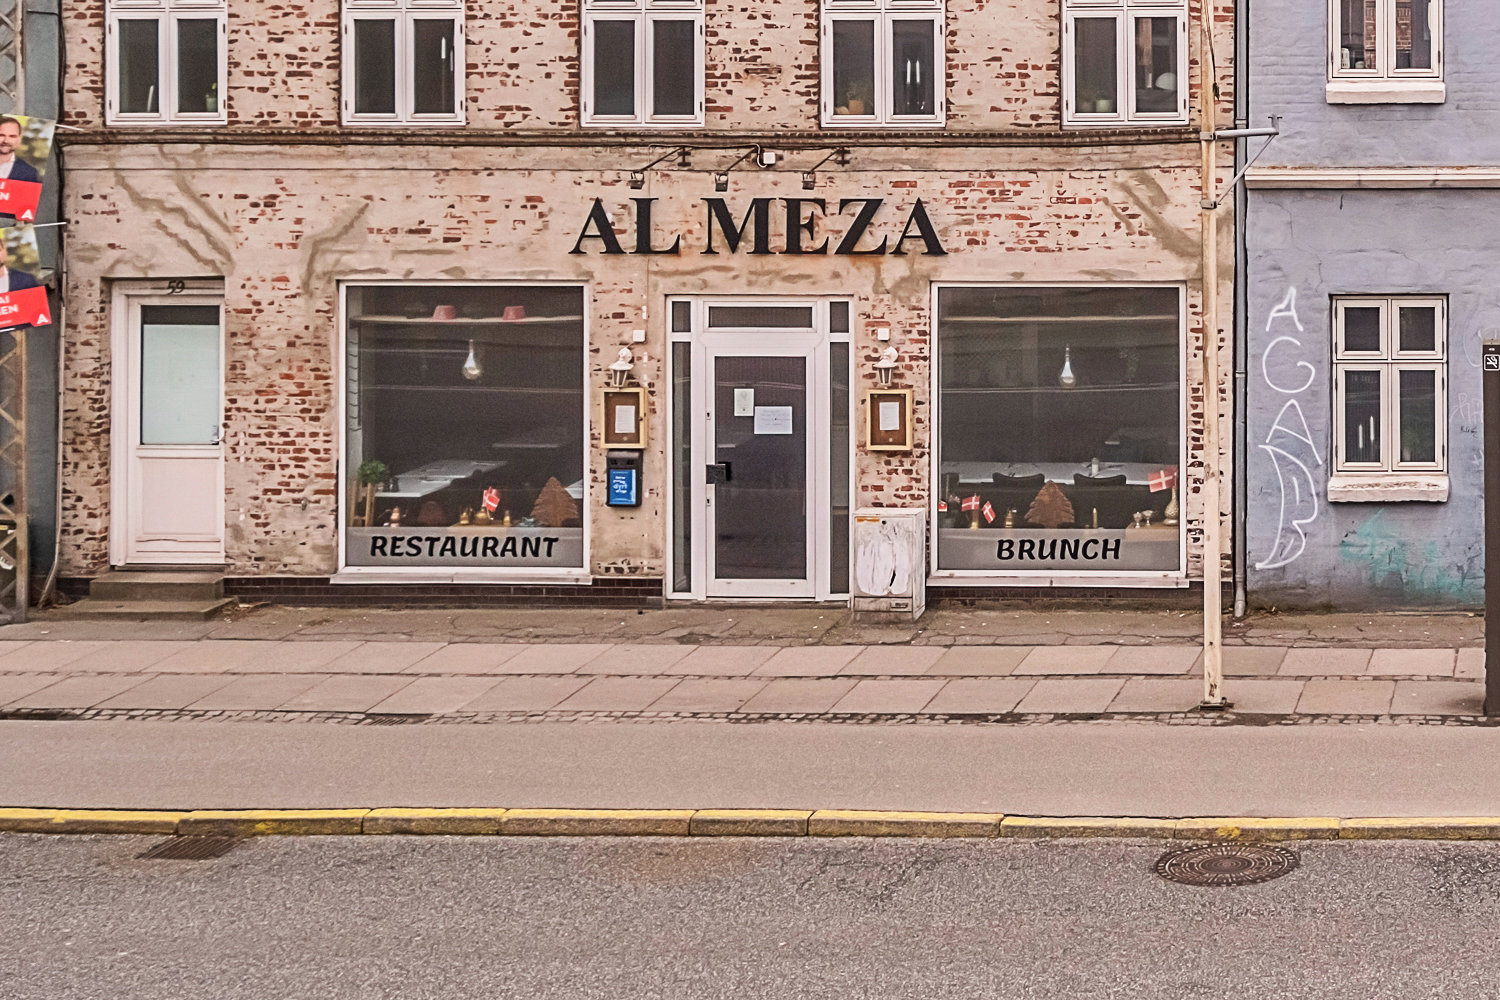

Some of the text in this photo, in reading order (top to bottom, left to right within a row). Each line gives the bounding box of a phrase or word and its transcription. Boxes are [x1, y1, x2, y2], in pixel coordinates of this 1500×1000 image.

[568, 197, 948, 255] AL MEZA
[168, 280, 184, 295] 59
[370, 535, 559, 558] RESTAURANT
[997, 538, 1121, 561] BRUNCH
